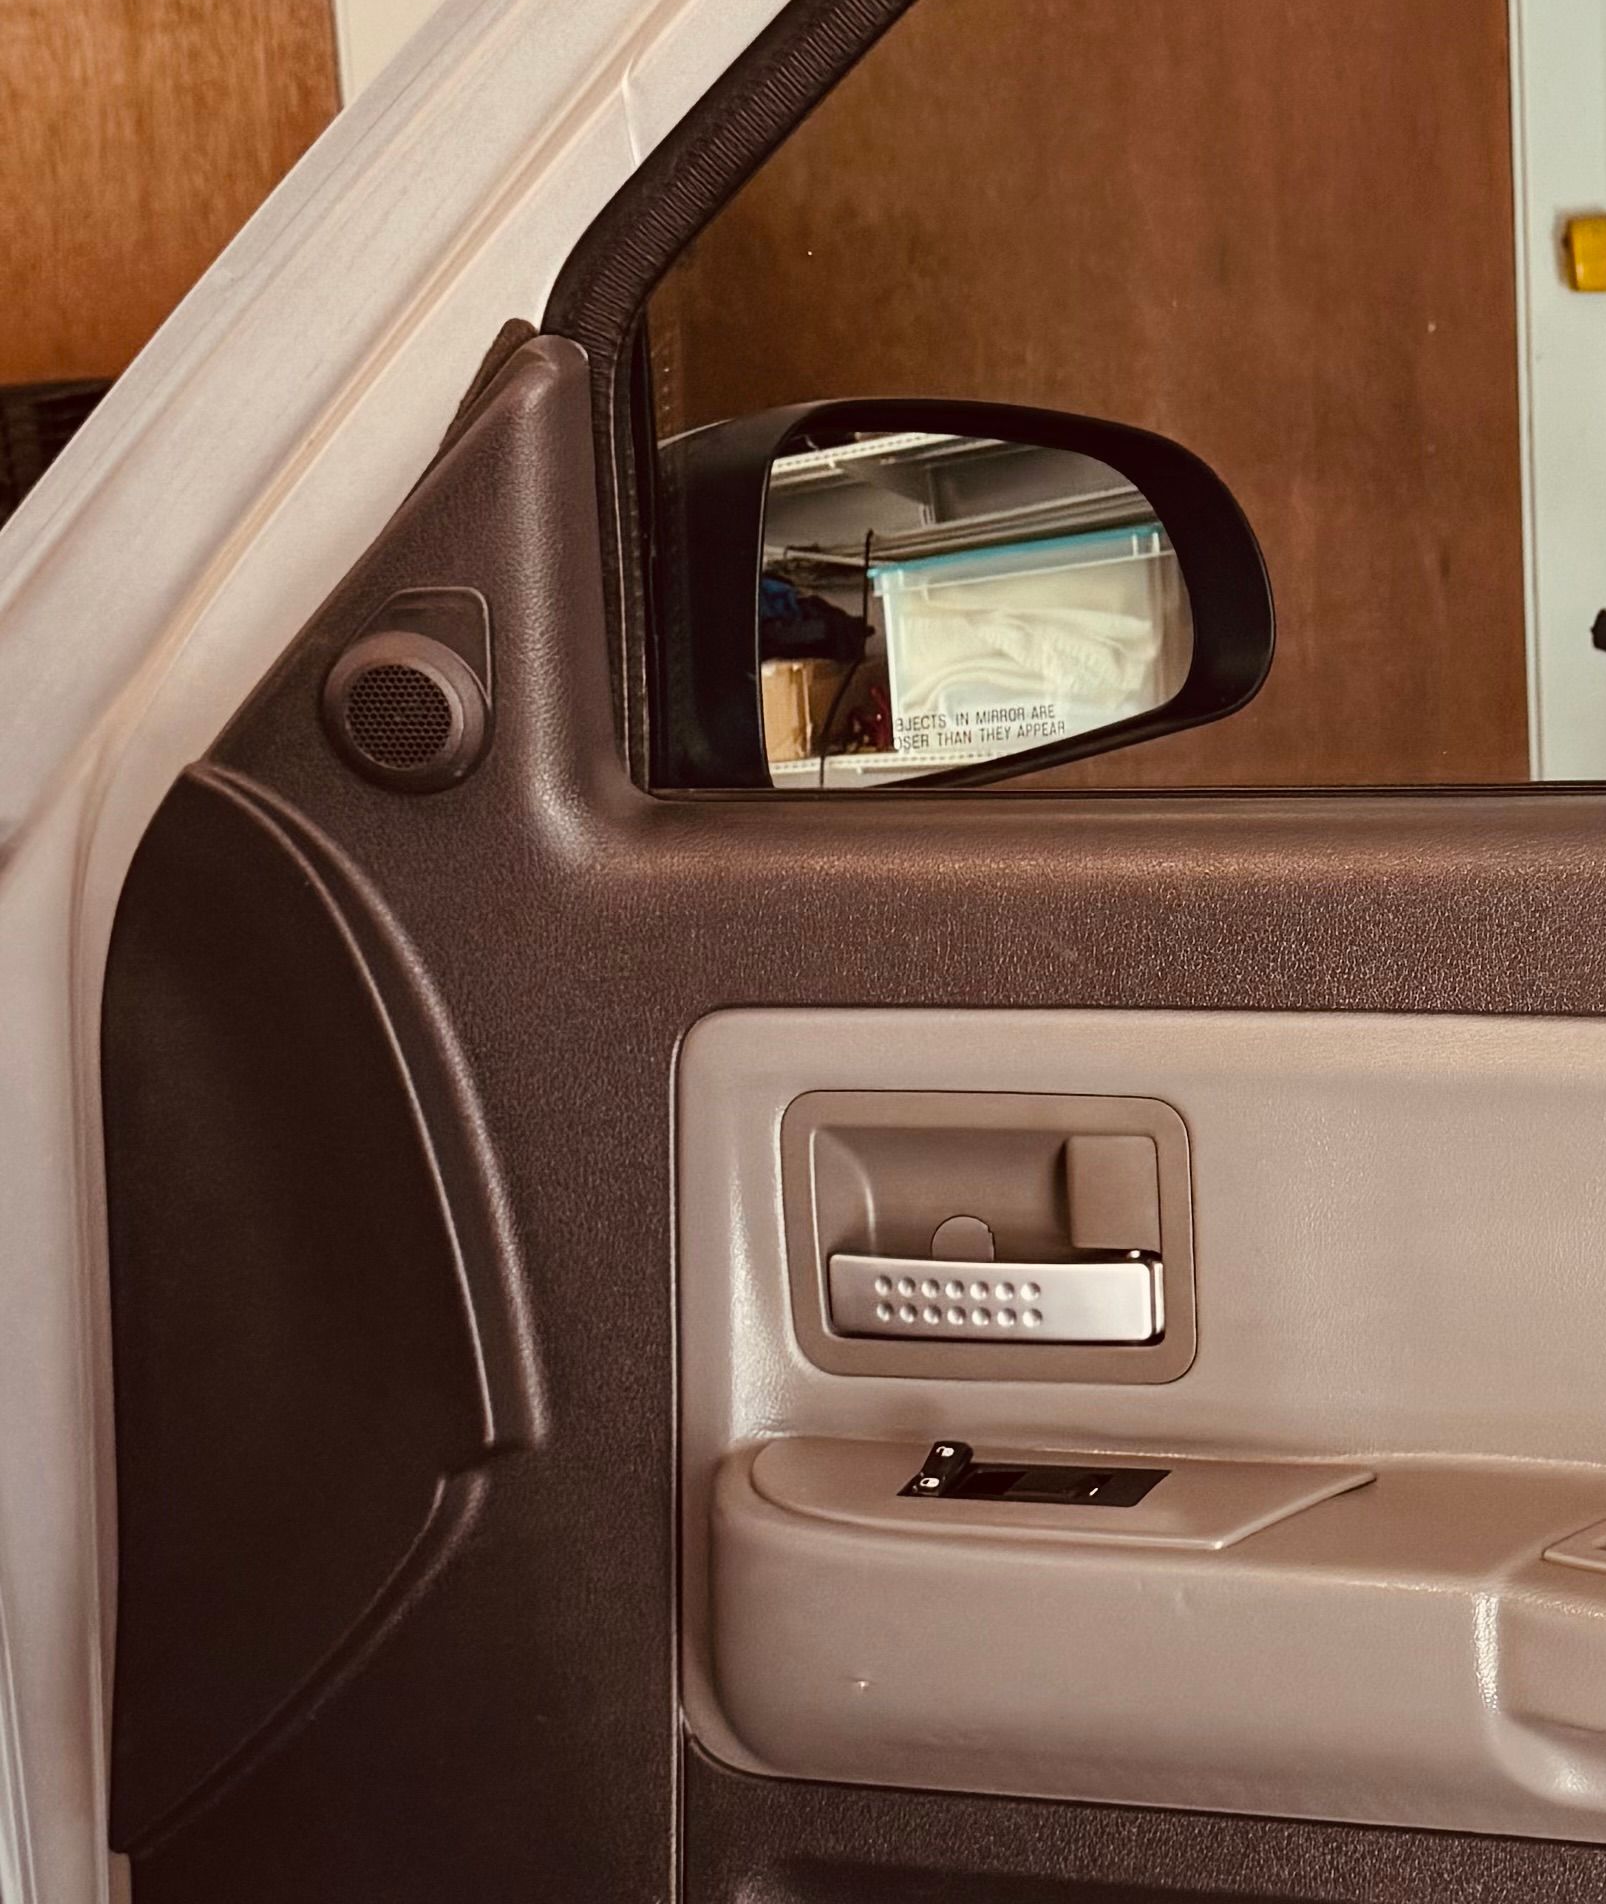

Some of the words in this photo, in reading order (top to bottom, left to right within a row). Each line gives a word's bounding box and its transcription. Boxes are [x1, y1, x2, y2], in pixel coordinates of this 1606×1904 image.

[895, 713, 947, 732] BJECTS
[955, 711, 969, 726] IN
[975, 707, 1025, 724] MIRROR
[1031, 704, 1055, 720] ARE
[938, 729, 972, 747] THAN
[979, 725, 1011, 742] THEY
[1017, 721, 1065, 738] APPEAR
